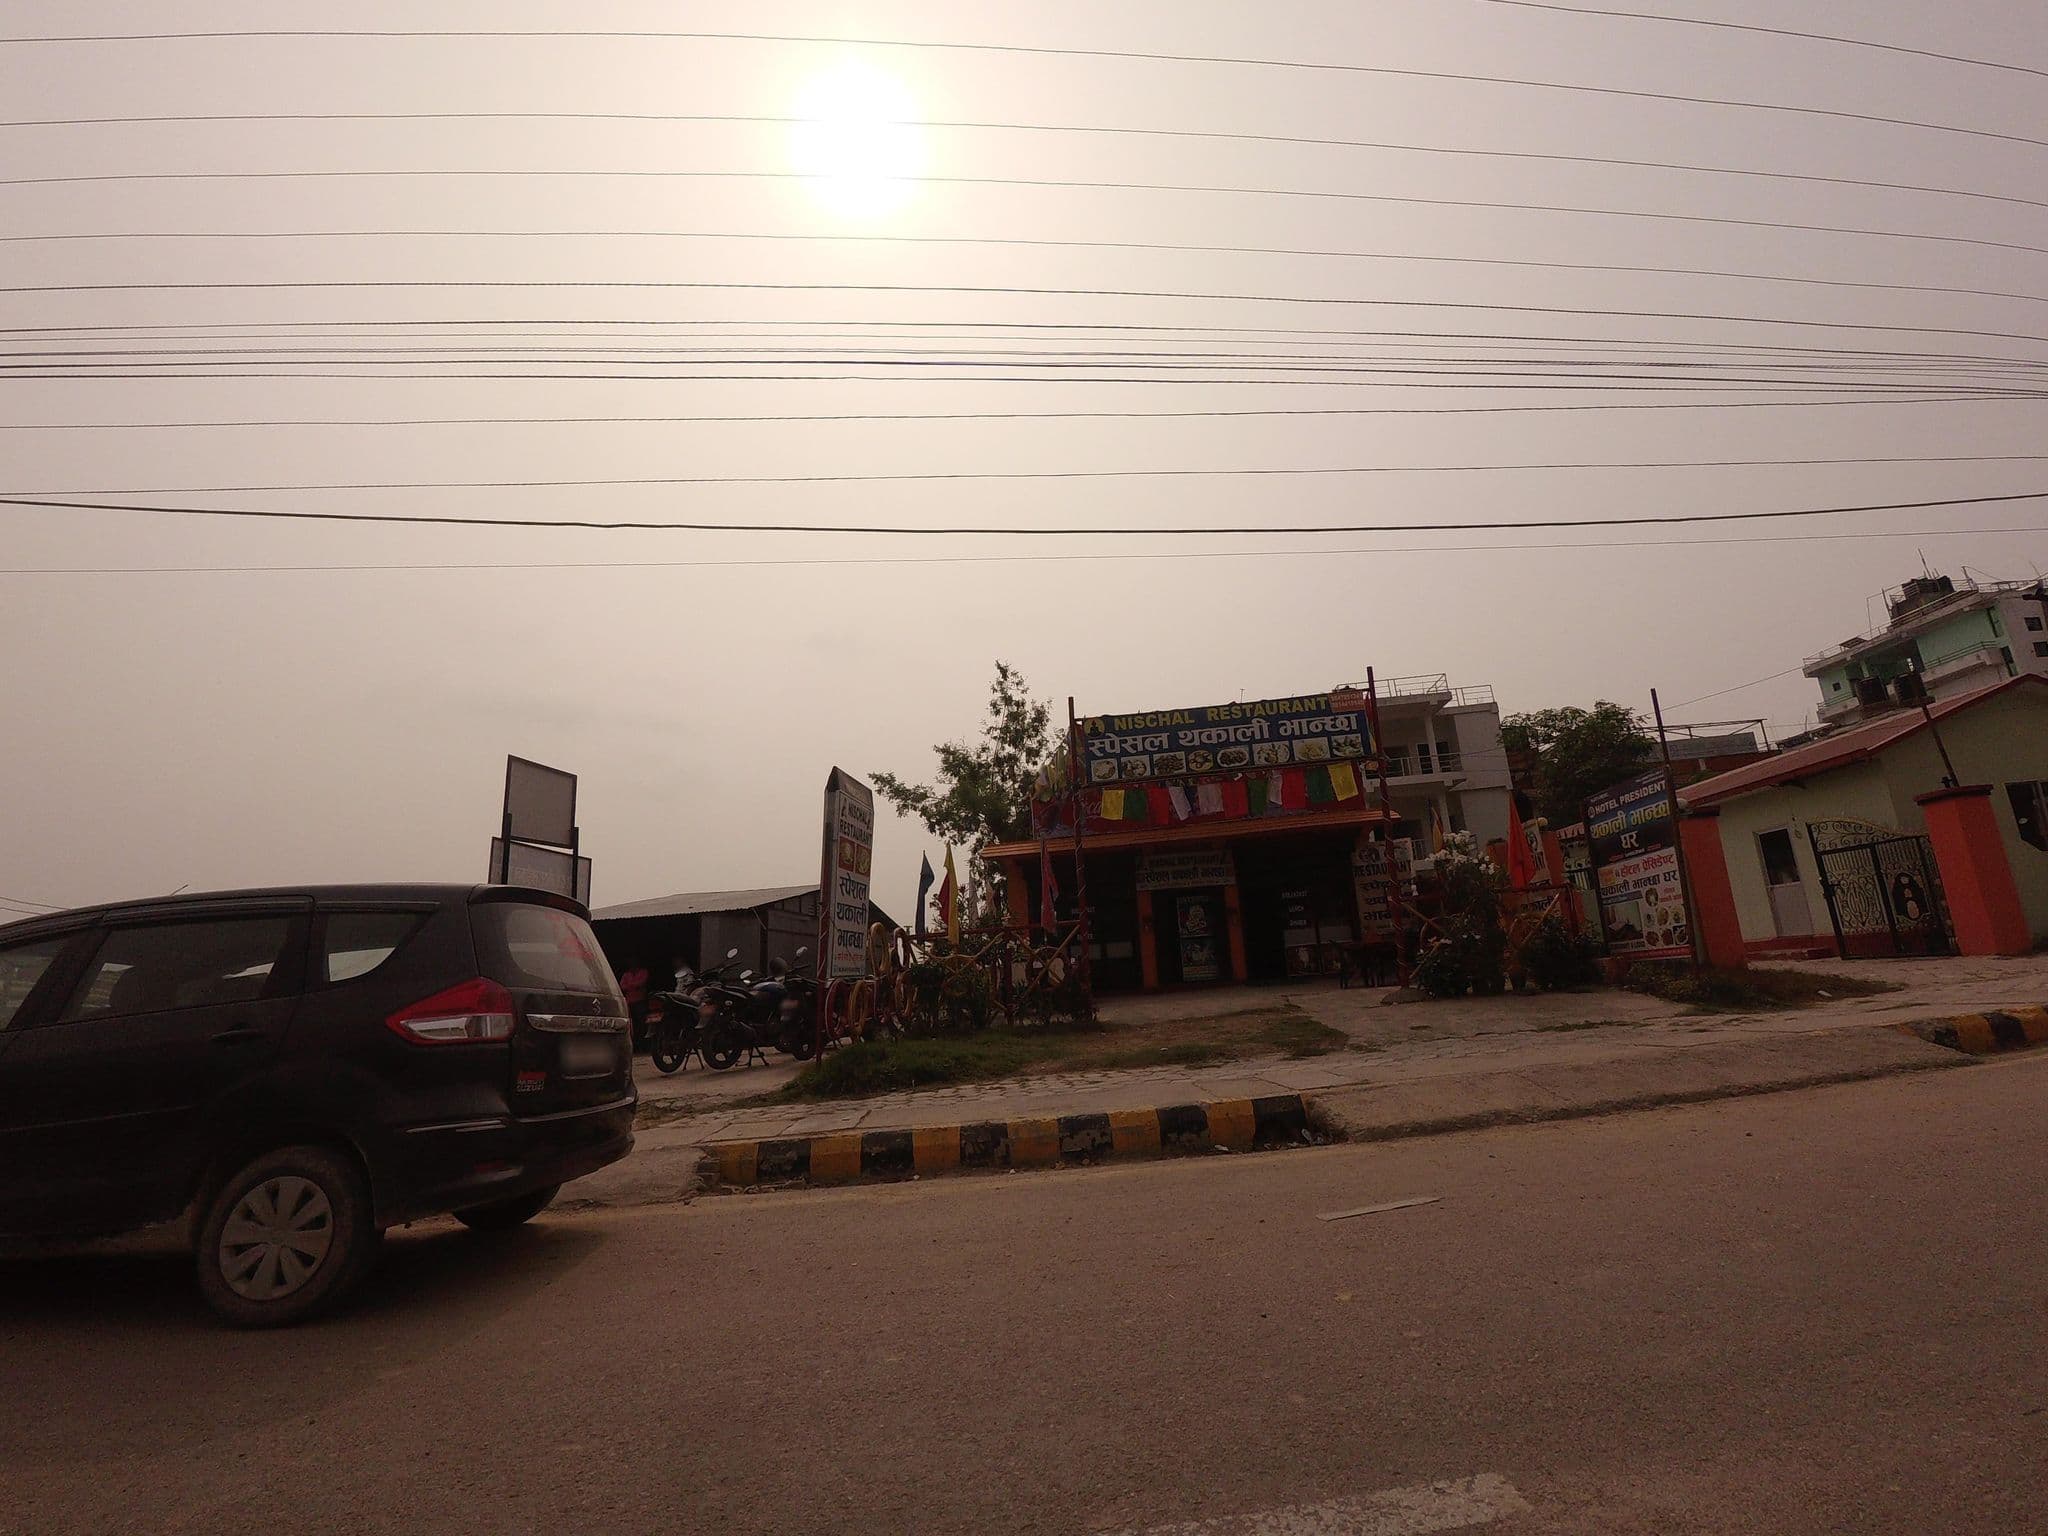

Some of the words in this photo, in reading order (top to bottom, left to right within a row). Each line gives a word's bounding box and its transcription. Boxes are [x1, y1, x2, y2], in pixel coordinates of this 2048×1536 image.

[1114, 711, 1195, 732] NISCHAL
[1207, 696, 1328, 722] RESTAURANT
[1087, 732, 1170, 757] स्पेसल
[1177, 720, 1272, 747] थकाली
[1279, 713, 1358, 737] भान्छा
[1595, 799, 1620, 814] HOTEL
[1620, 780, 1666, 805] PRESIDENT
[840, 818, 873, 849] RESTAURANT
[1590, 810, 1627, 839] थकाली
[1620, 831, 1639, 849] घर
[1353, 860, 1411, 879] RESTAUANT
[1600, 879, 1630, 897] थकाली
[1663, 870, 1679, 882] घर
[836, 901, 868, 926] थकाली
[837, 929, 865, 950] भान्छा
